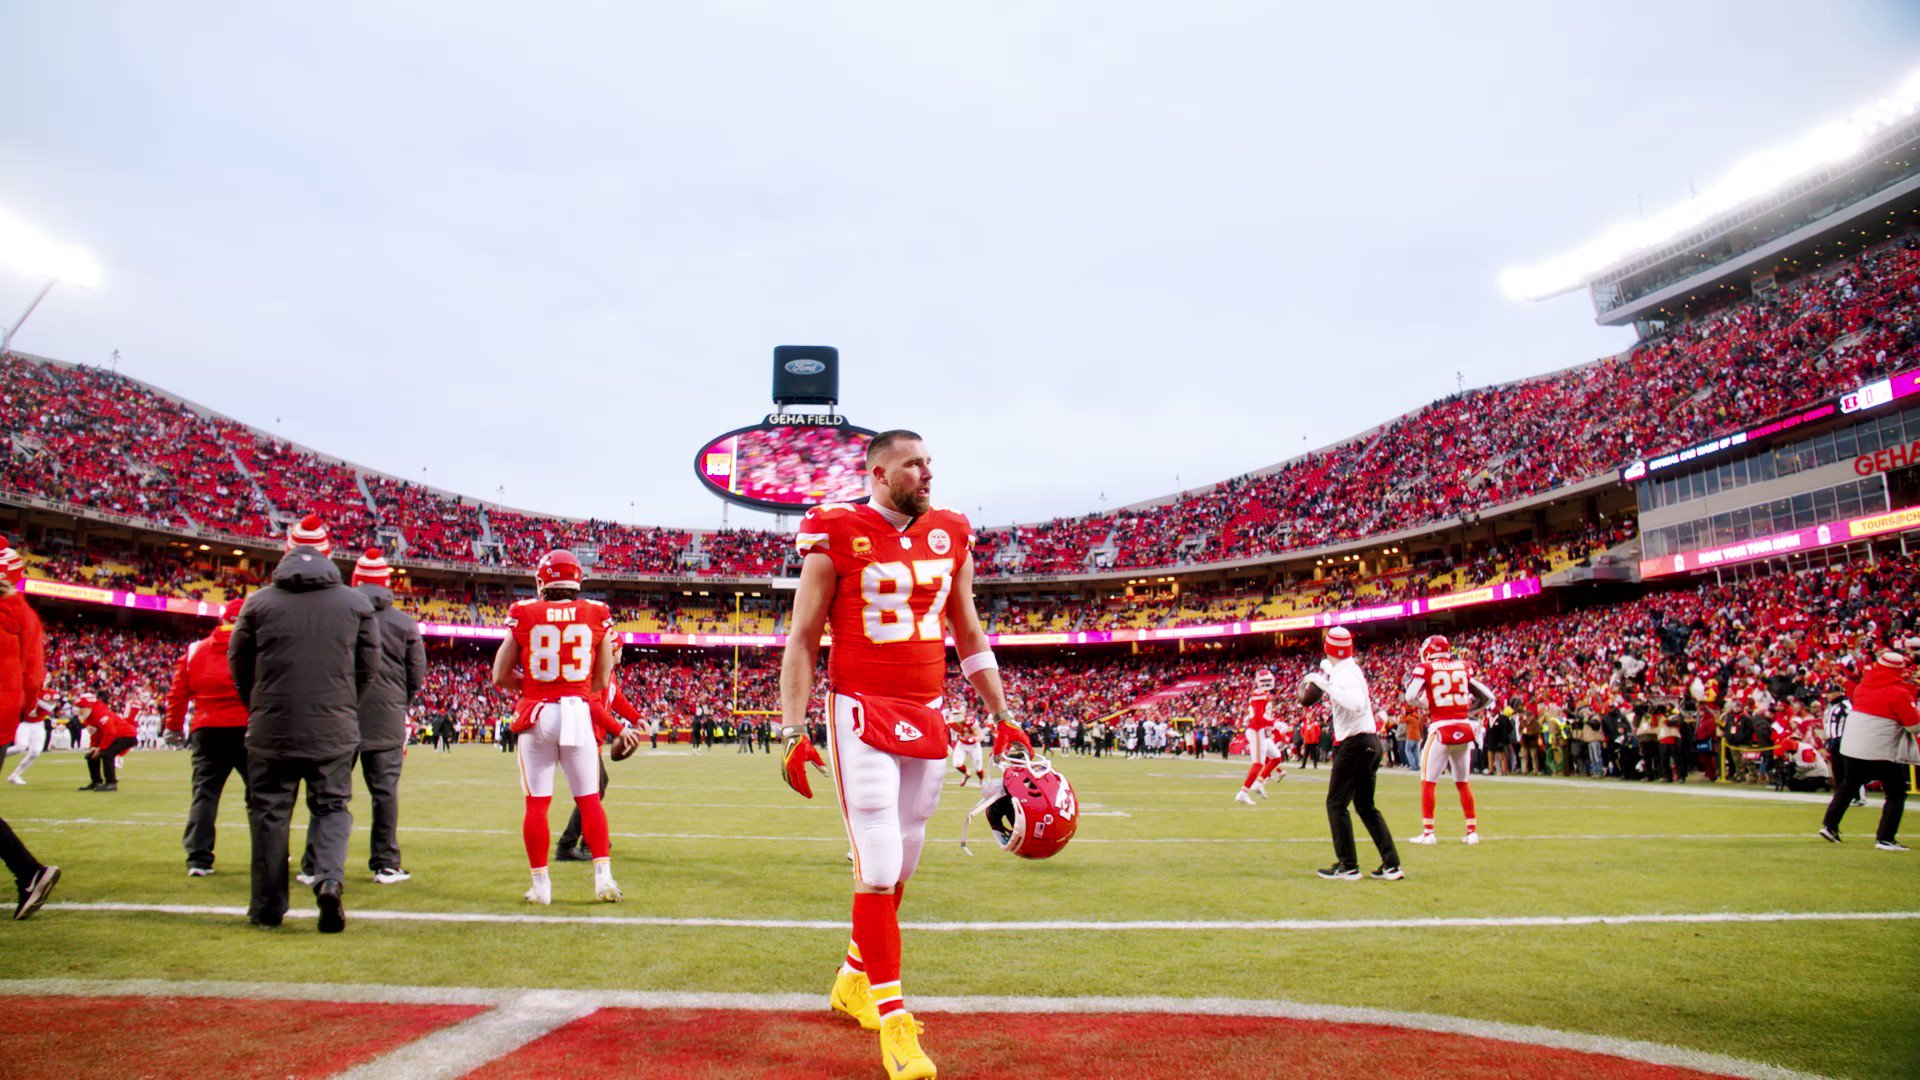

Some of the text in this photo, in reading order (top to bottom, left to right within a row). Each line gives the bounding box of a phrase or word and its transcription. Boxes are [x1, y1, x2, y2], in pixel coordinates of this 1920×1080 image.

[792, 362, 818, 372] Ford
[768, 414, 843, 426] GEHA FIELD
[197, 531, 220, 541] MARTY
[852, 536, 872, 552] C
[861, 557, 954, 644] 87
[546, 607, 577, 622] GRAY
[529, 623, 593, 682] 83
[1431, 670, 1469, 707] 23
